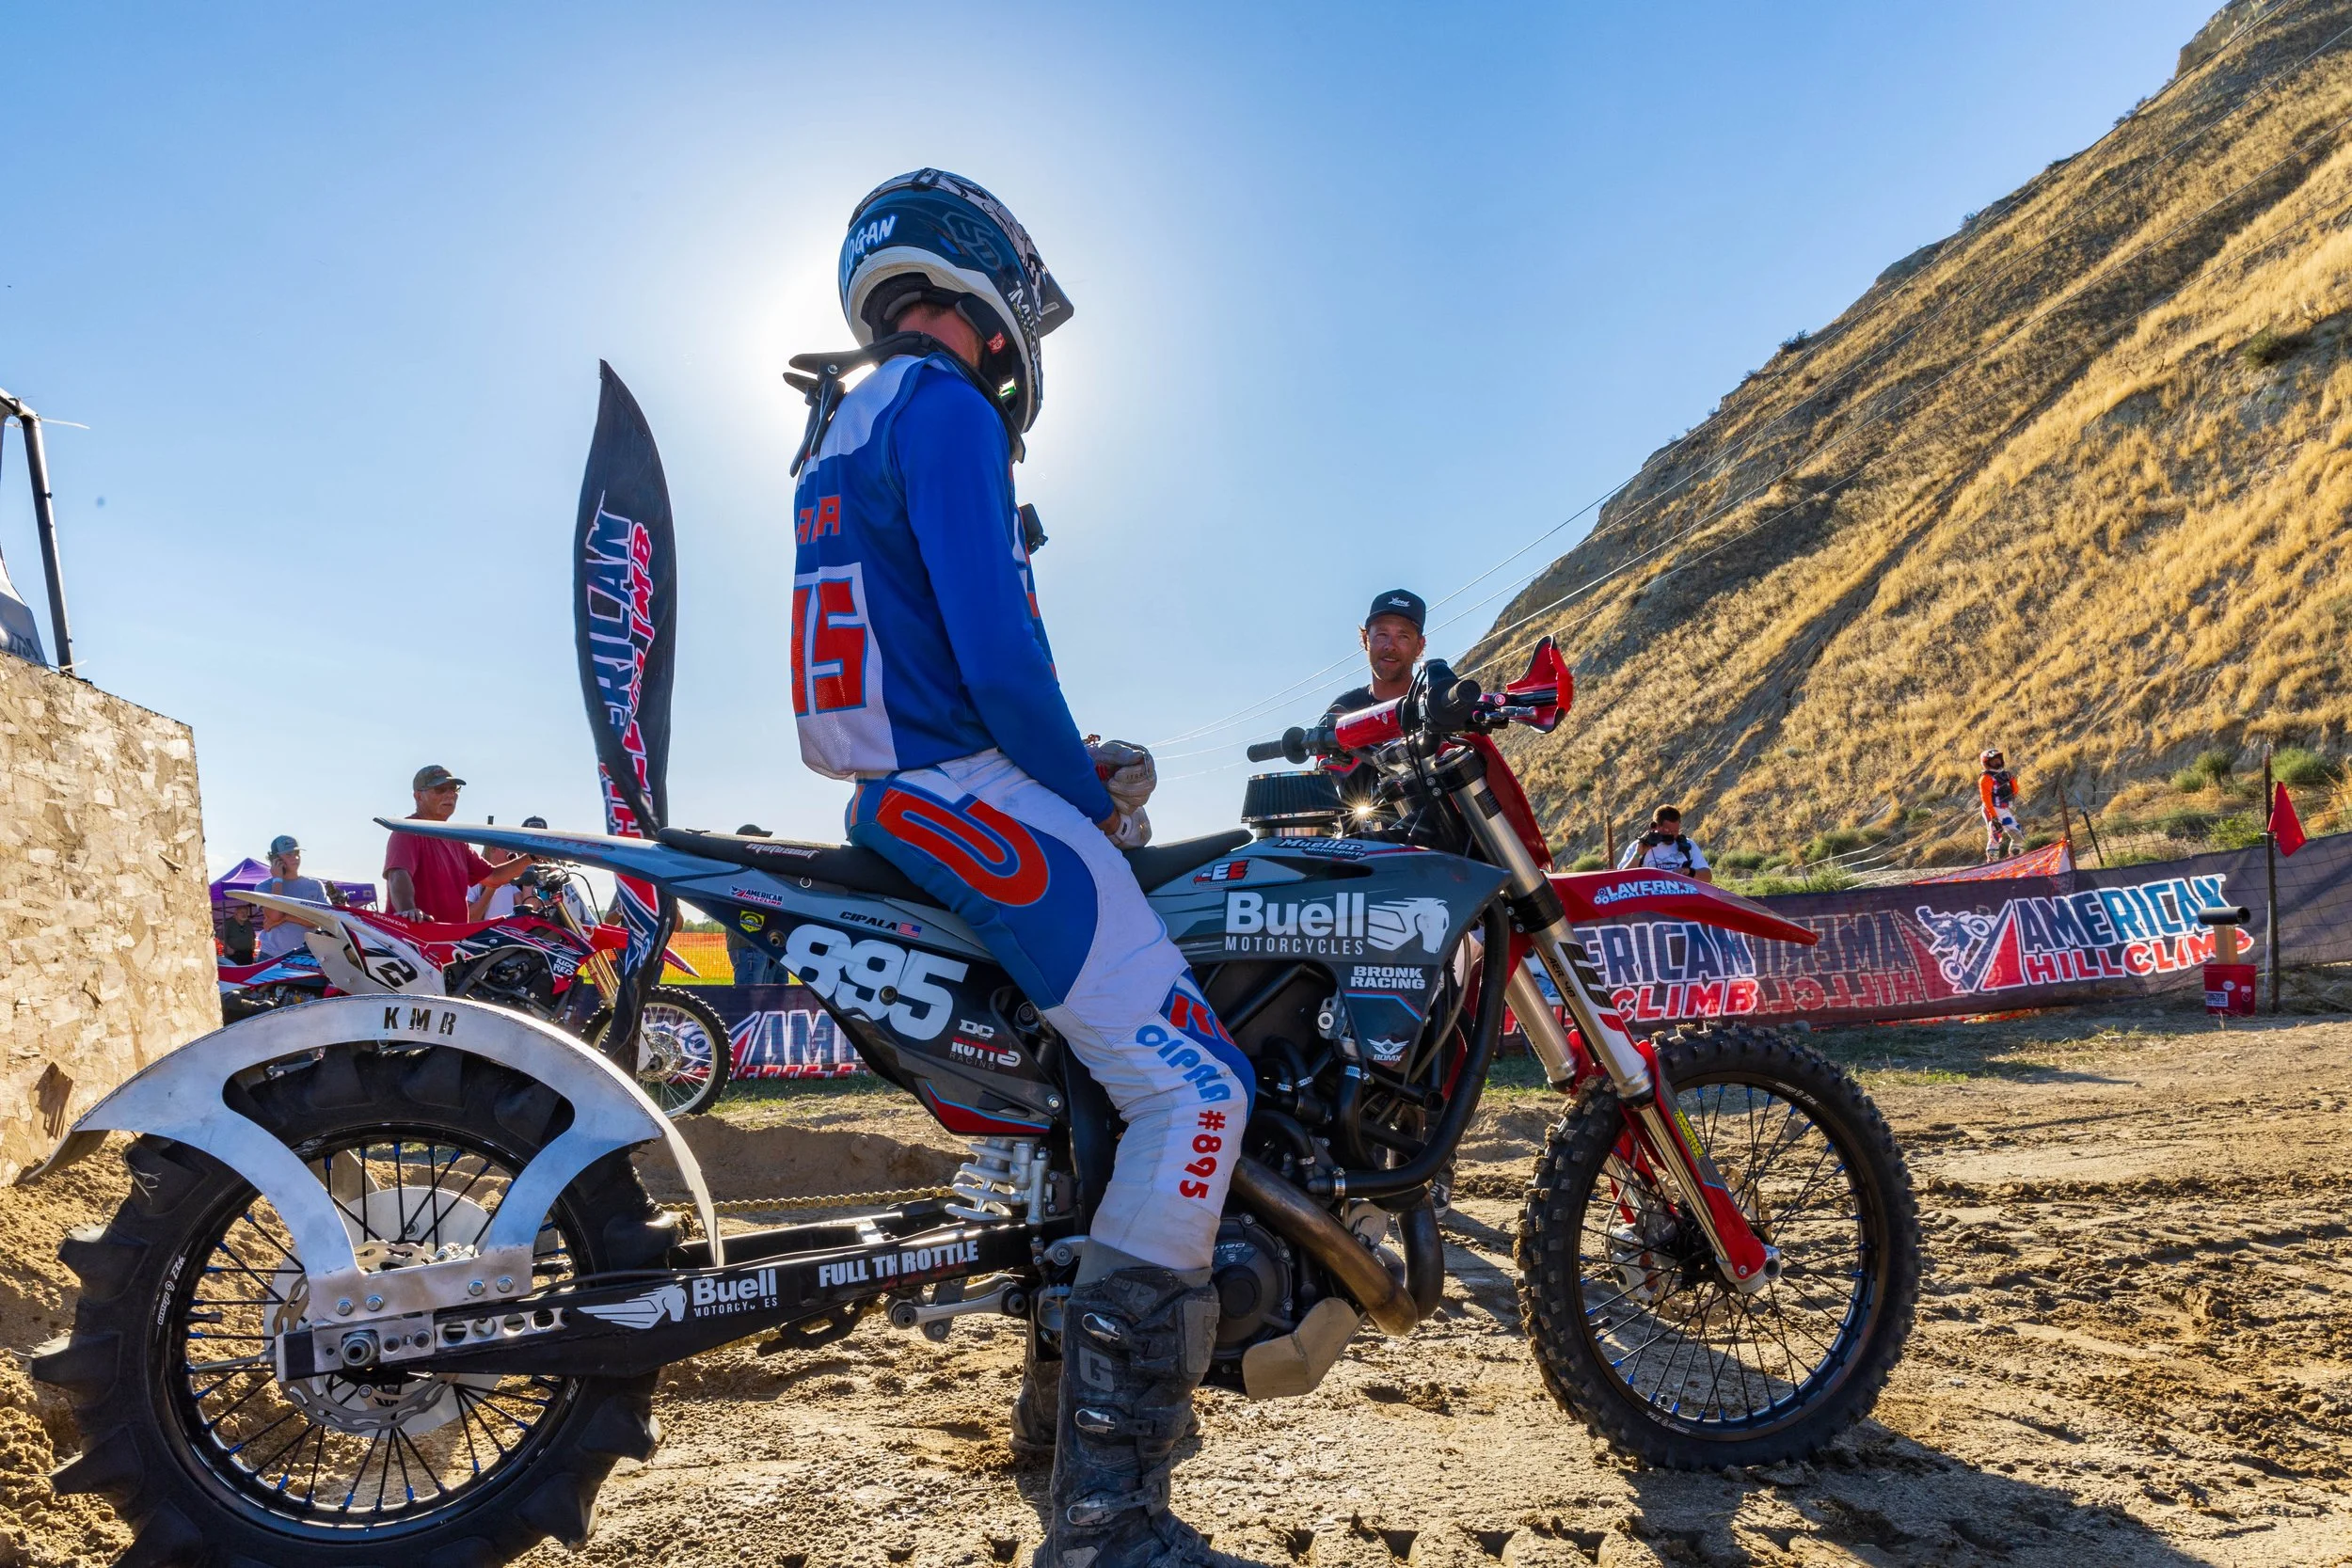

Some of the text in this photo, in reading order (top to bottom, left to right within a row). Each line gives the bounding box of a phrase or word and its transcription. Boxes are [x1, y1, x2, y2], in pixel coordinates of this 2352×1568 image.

[845, 214, 896, 286] LOGAN
[1279, 838, 1362, 851] Mueller
[1305, 847, 1366, 857] Motorsports
[745, 888, 784, 902] AMERICAN
[1610, 891, 1650, 903] SMALL
[373, 912, 409, 929] HONDA
[838, 911, 898, 931] CIPALA
[1224, 892, 1365, 938] Buell
[2014, 874, 2228, 954] AMERICAN
[1224, 936, 1365, 956] MOTORCYCLES
[1574, 921, 1756, 988] ERICAN
[553, 963, 574, 976] RED
[555, 958, 576, 972] RIDE
[1353, 965, 1423, 979] BRONK
[1350, 975, 1426, 990] RACING
[948, 1053, 995, 1070] RACING
[1179, 1109, 1226, 1199] #895
[818, 1262, 869, 1288] FULL
[692, 1268, 777, 1306] Buell
[693, 1297, 778, 1317] MOTORCYES
